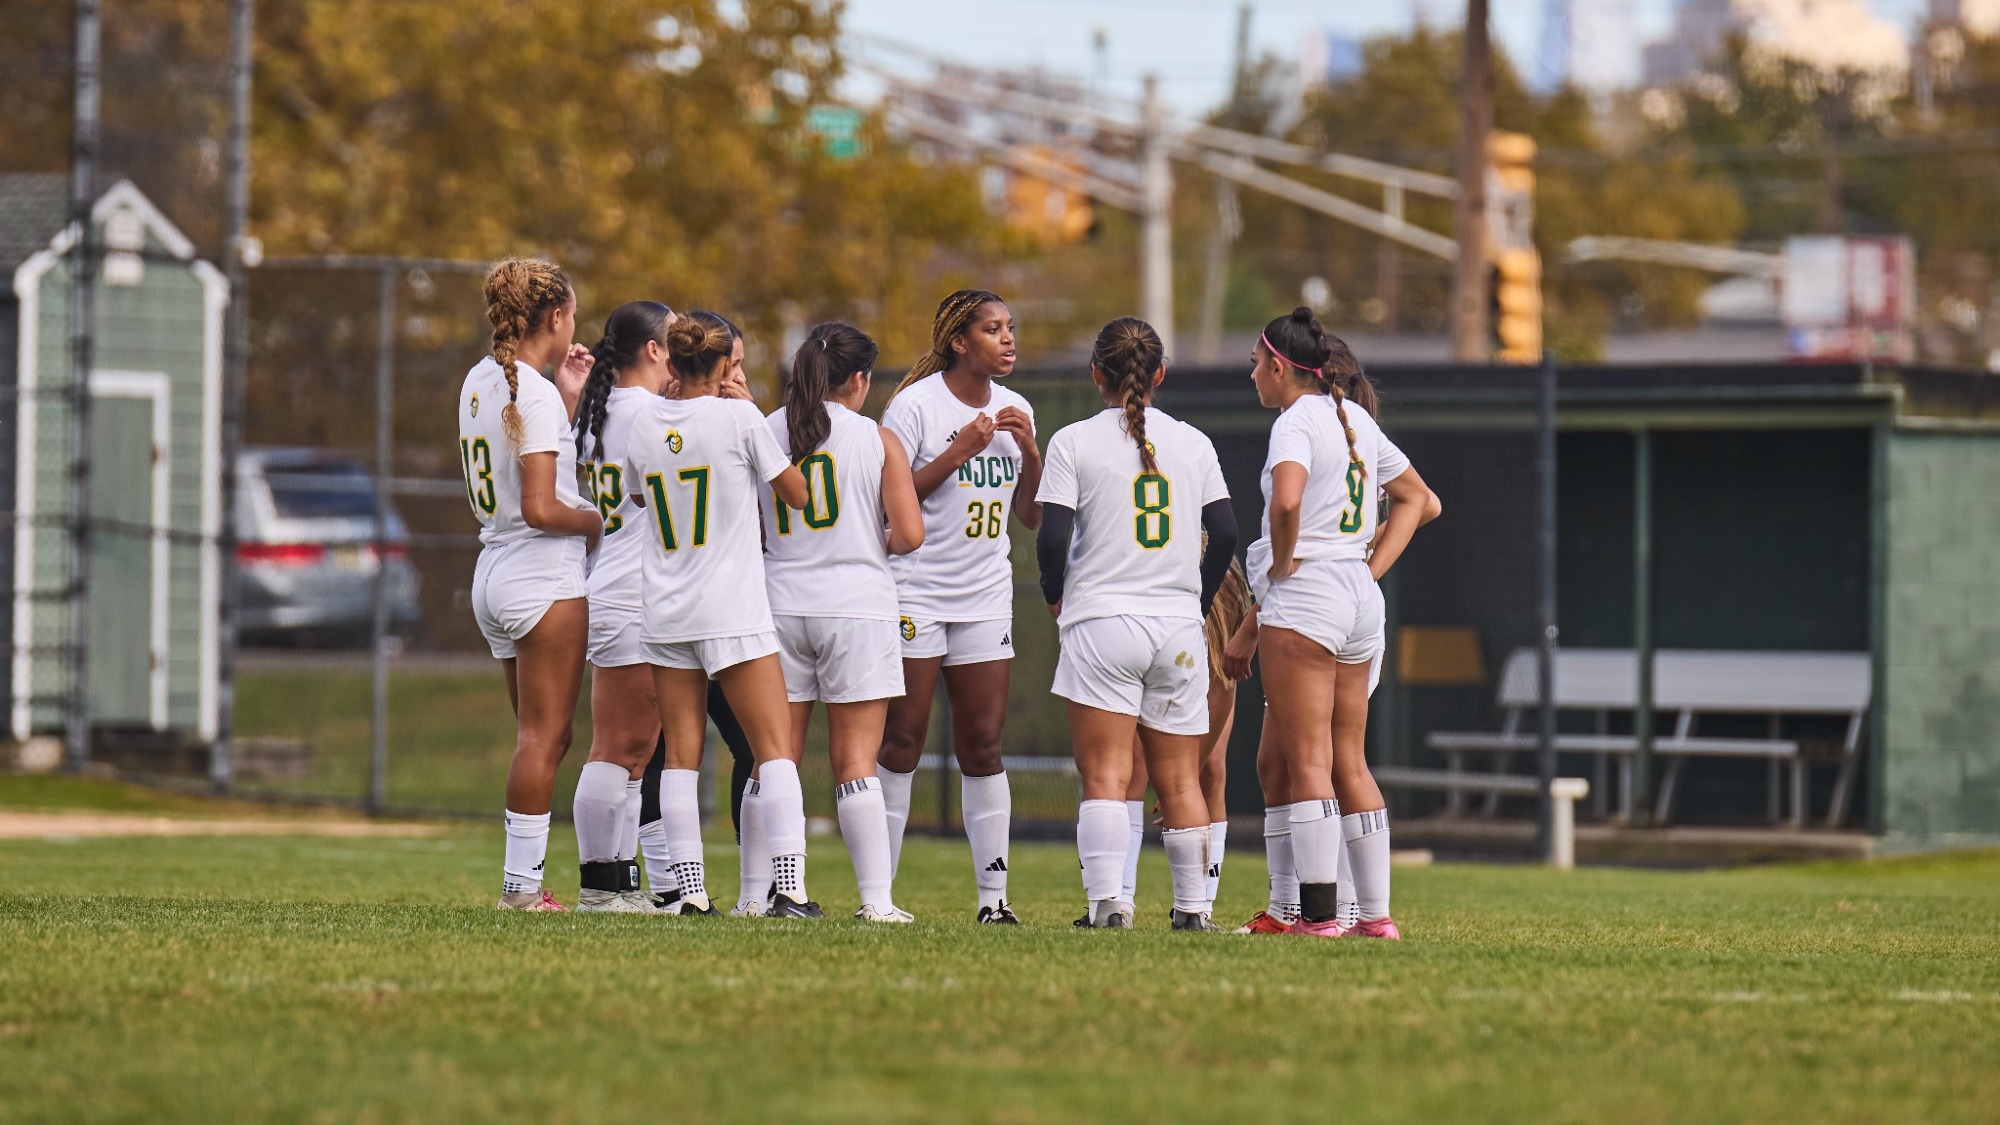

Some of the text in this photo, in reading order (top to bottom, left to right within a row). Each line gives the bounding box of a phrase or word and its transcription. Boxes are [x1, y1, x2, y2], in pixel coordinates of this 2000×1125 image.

[645, 464, 710, 552] 17
[958, 456, 1015, 488] NJCU
[1132, 470, 1172, 551] 8
[1338, 456, 1366, 536] 9
[965, 499, 1003, 540] 36
